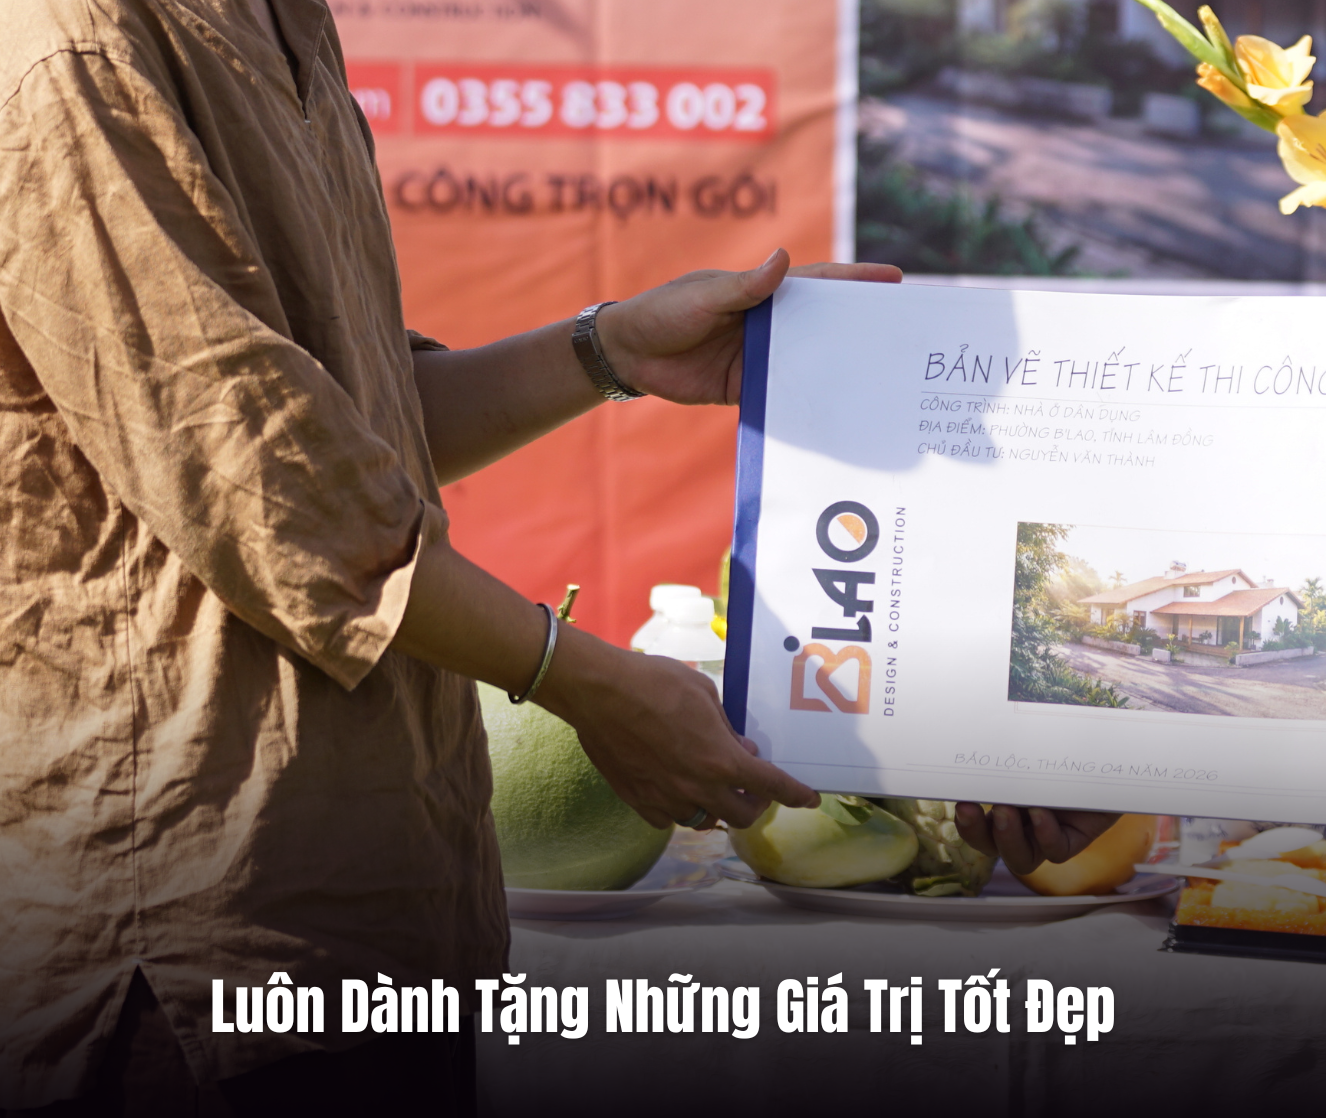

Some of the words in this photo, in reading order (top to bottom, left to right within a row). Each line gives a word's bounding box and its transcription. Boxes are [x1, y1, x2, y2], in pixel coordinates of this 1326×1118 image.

[420, 75, 553, 128] 0355
[560, 79, 657, 129] 833
[666, 83, 767, 131] 002
[395, 166, 533, 215] CÔNG
[924, 343, 993, 384] BẢN
[1005, 349, 1042, 386] VẼ
[1053, 345, 1141, 391] THIẾT
[1148, 348, 1192, 392] KẾ
[1200, 364, 1243, 394] THI
[920, 395, 962, 412] CÔNG
[967, 397, 1010, 415] TRÌNH:
[1014, 401, 1044, 417] NHÀ
[1063, 403, 1094, 420] DÂN
[1099, 408, 1142, 423] DỤNG
[918, 419, 942, 436] ĐỊA
[946, 417, 986, 436] ĐIỂM:
[990, 423, 1051, 440] PHƯỜNG
[1137, 428, 1168, 446] LÂM
[1172, 427, 1214, 448] ĐỒNG
[917, 439, 947, 457] CHỦ
[950, 438, 982, 459] ĐẦU
[985, 446, 1005, 459] TƯ:
[1009, 444, 1069, 463] NGUYỄN
[1074, 449, 1102, 465] VĂN
[1107, 450, 1156, 468] THÀNH
[888, 506, 907, 632] CONSTRUCTION
[887, 640, 900, 650] &
[883, 656, 898, 717] DESIGN
[953, 751, 991, 767] BẢO
[1037, 756, 1096, 774] THÁNG
[1100, 762, 1124, 776] 04
[1128, 763, 1168, 779] NĂM
[1173, 767, 1219, 783] 2026
